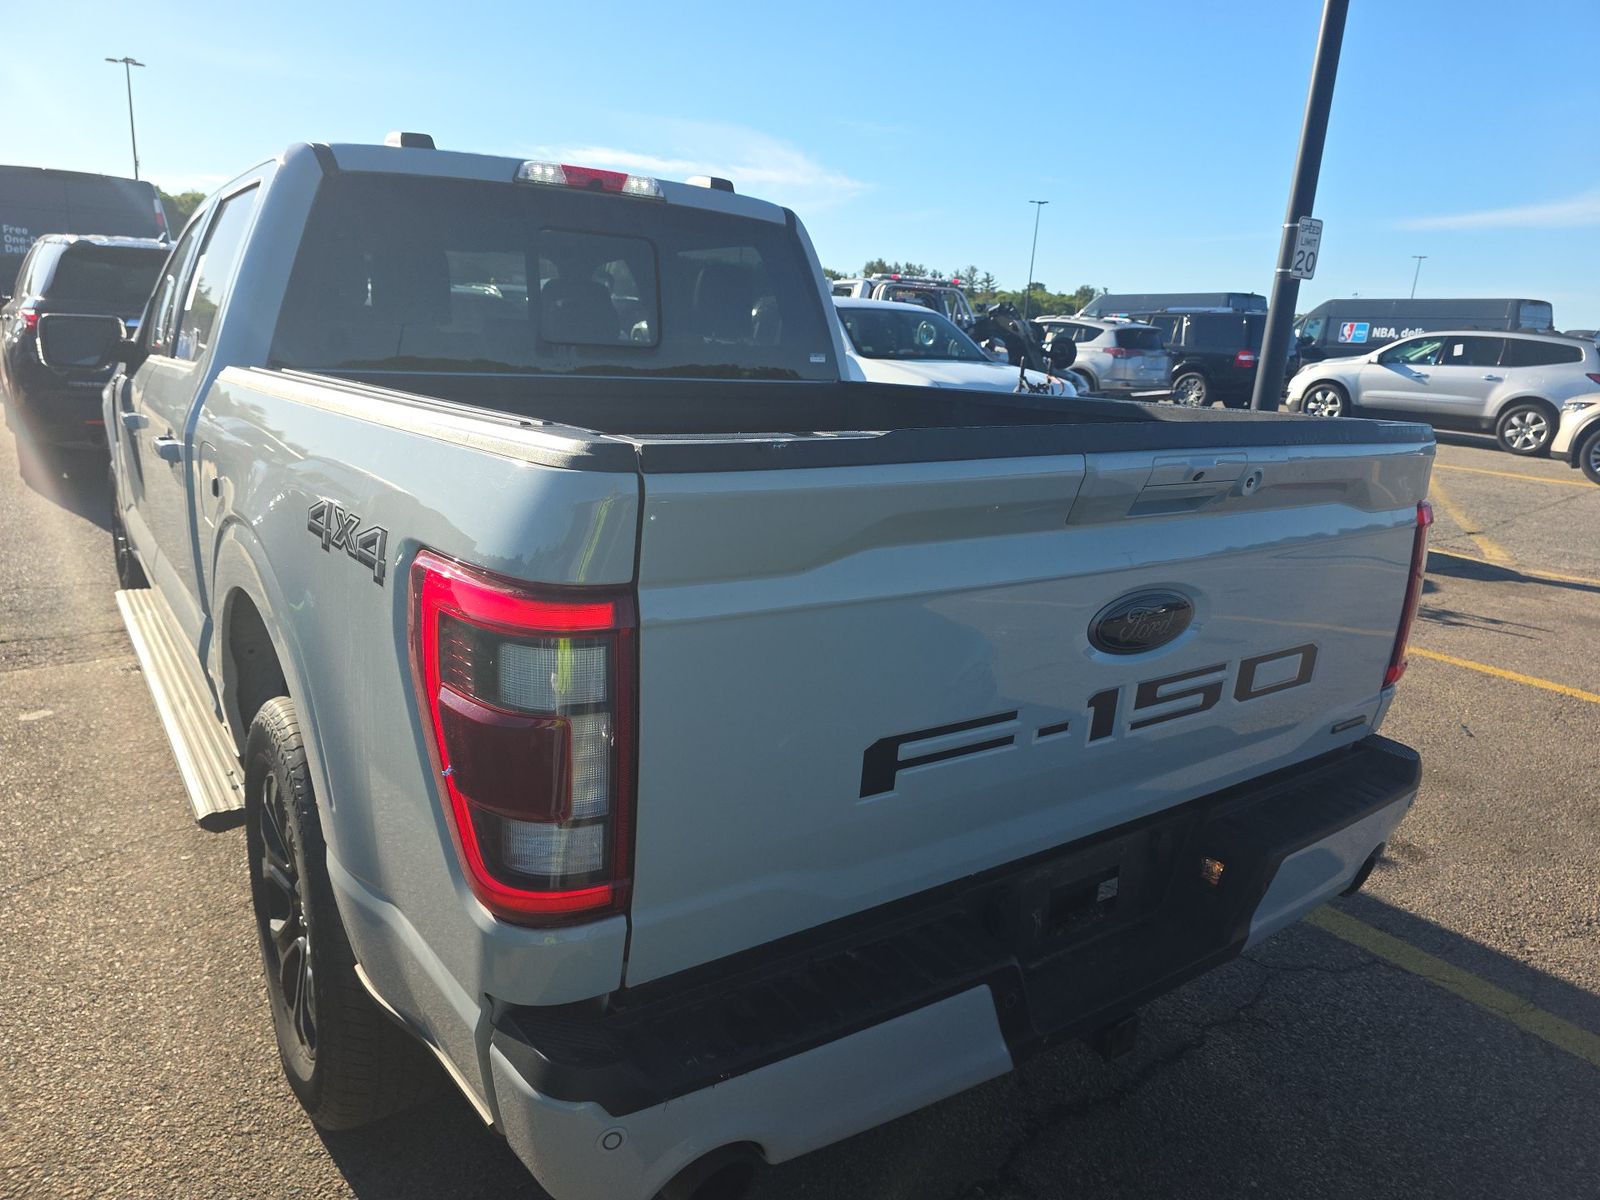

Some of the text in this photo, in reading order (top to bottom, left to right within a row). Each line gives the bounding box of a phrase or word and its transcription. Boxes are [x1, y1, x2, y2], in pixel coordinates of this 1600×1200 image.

[3, 224, 28, 235] Free
[1301, 222, 1321, 235] SPEED
[1300, 236, 1317, 247] LIMIT
[1294, 250, 1316, 273] 20
[1372, 327, 1399, 339] NBA,
[1120, 606, 1175, 640] Ford
[859, 643, 1317, 799] F-150
